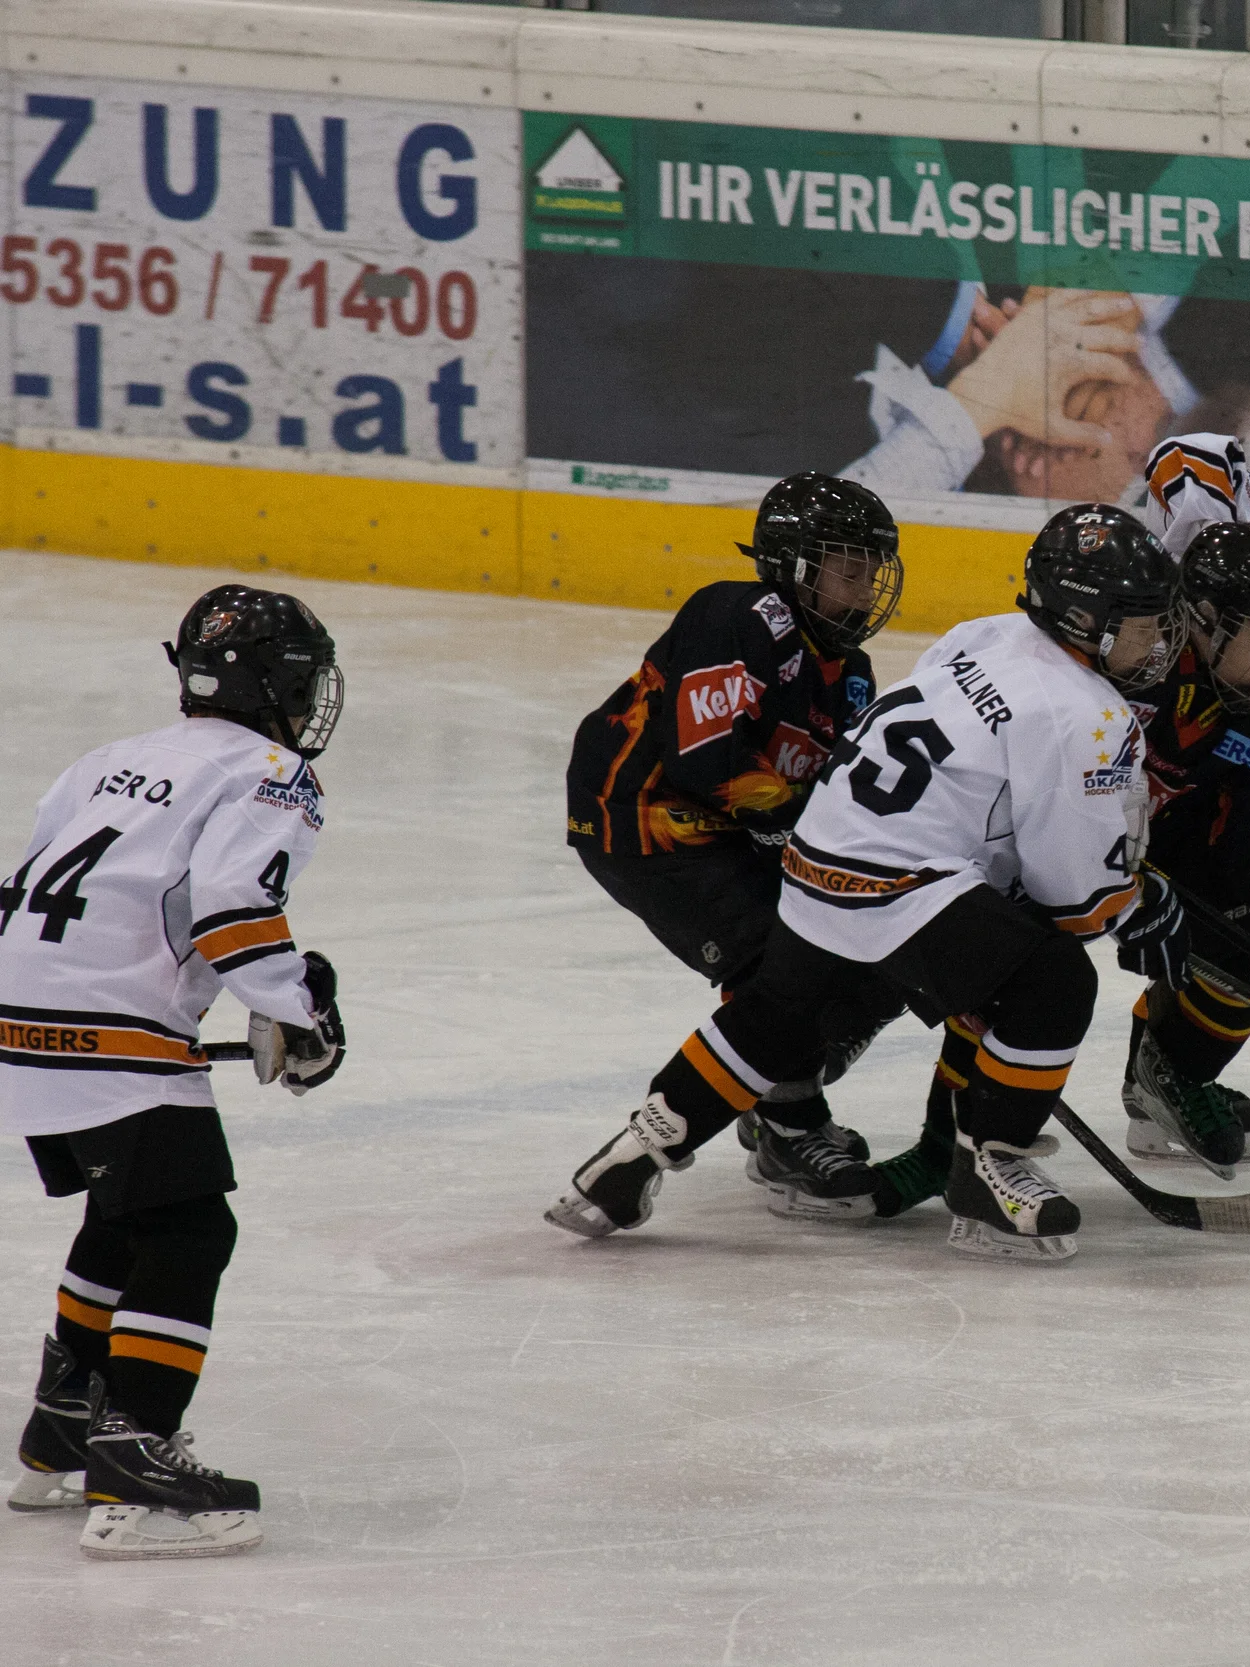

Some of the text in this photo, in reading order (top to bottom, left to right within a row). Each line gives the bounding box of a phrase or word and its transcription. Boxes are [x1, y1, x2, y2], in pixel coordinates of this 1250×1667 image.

[21, 92, 478, 242] ZUNG
[658, 160, 755, 225] IHR
[763, 162, 1223, 259] VERLÄSSLICHER
[0, 235, 179, 317] 5356
[248, 255, 479, 341] 71400
[1059, 578, 1100, 596] BAUER
[283, 652, 312, 662] BAUER
[1056, 620, 1090, 639] BAUER
